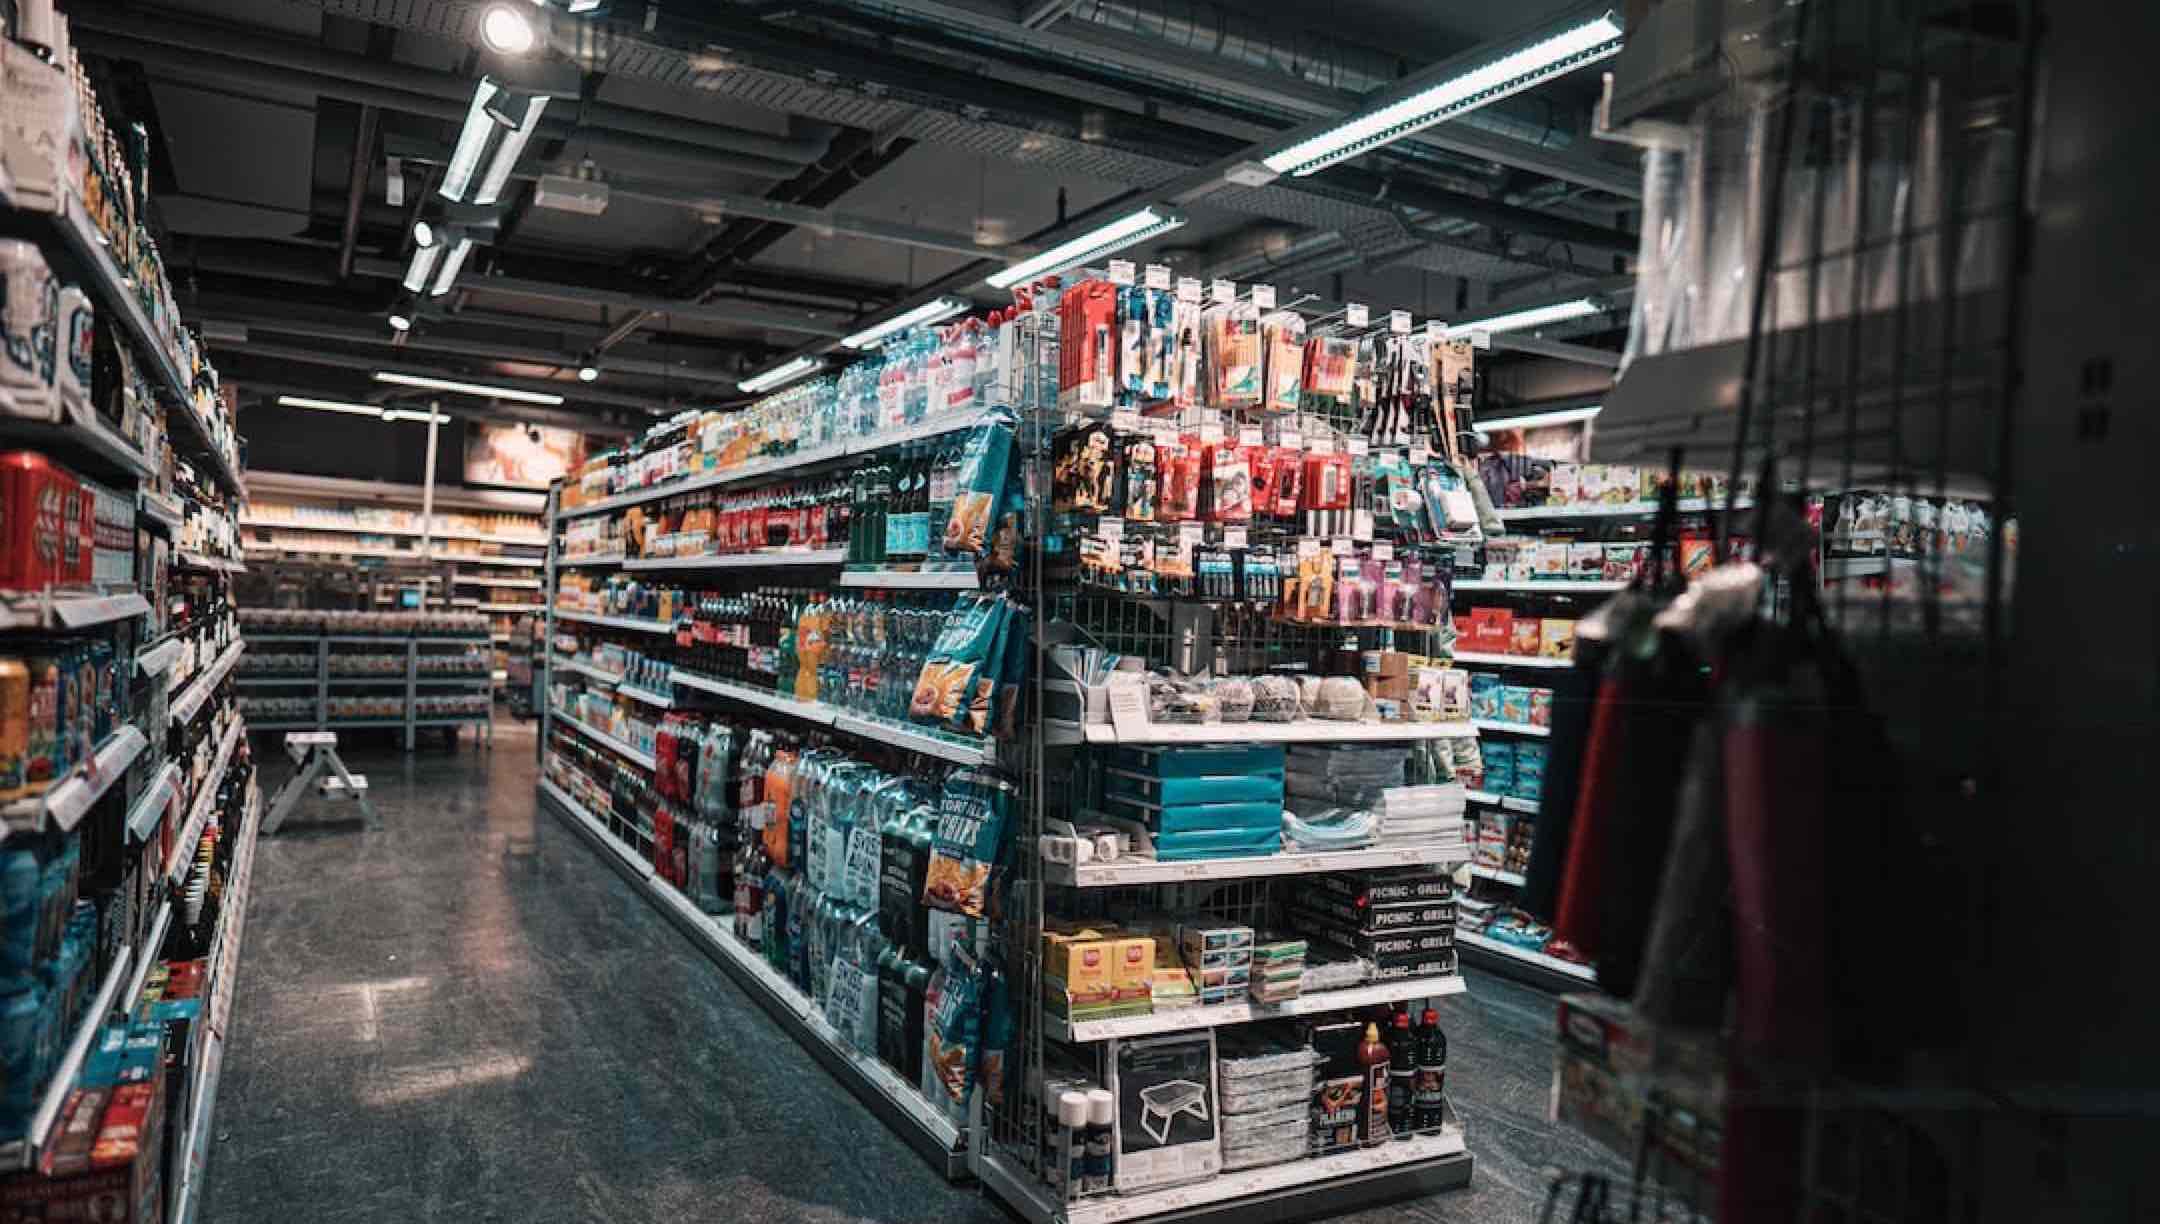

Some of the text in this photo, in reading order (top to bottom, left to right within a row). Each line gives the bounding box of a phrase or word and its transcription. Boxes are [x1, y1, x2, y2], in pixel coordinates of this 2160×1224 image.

[1369, 885, 1408, 900] PICNIC
[1417, 883, 1450, 896] GRILL
[1375, 911, 1416, 928] PICNIC
[1422, 908, 1454, 921] GRILL
[1375, 939, 1413, 953] PICNIC
[1420, 936, 1451, 949] GRILL
